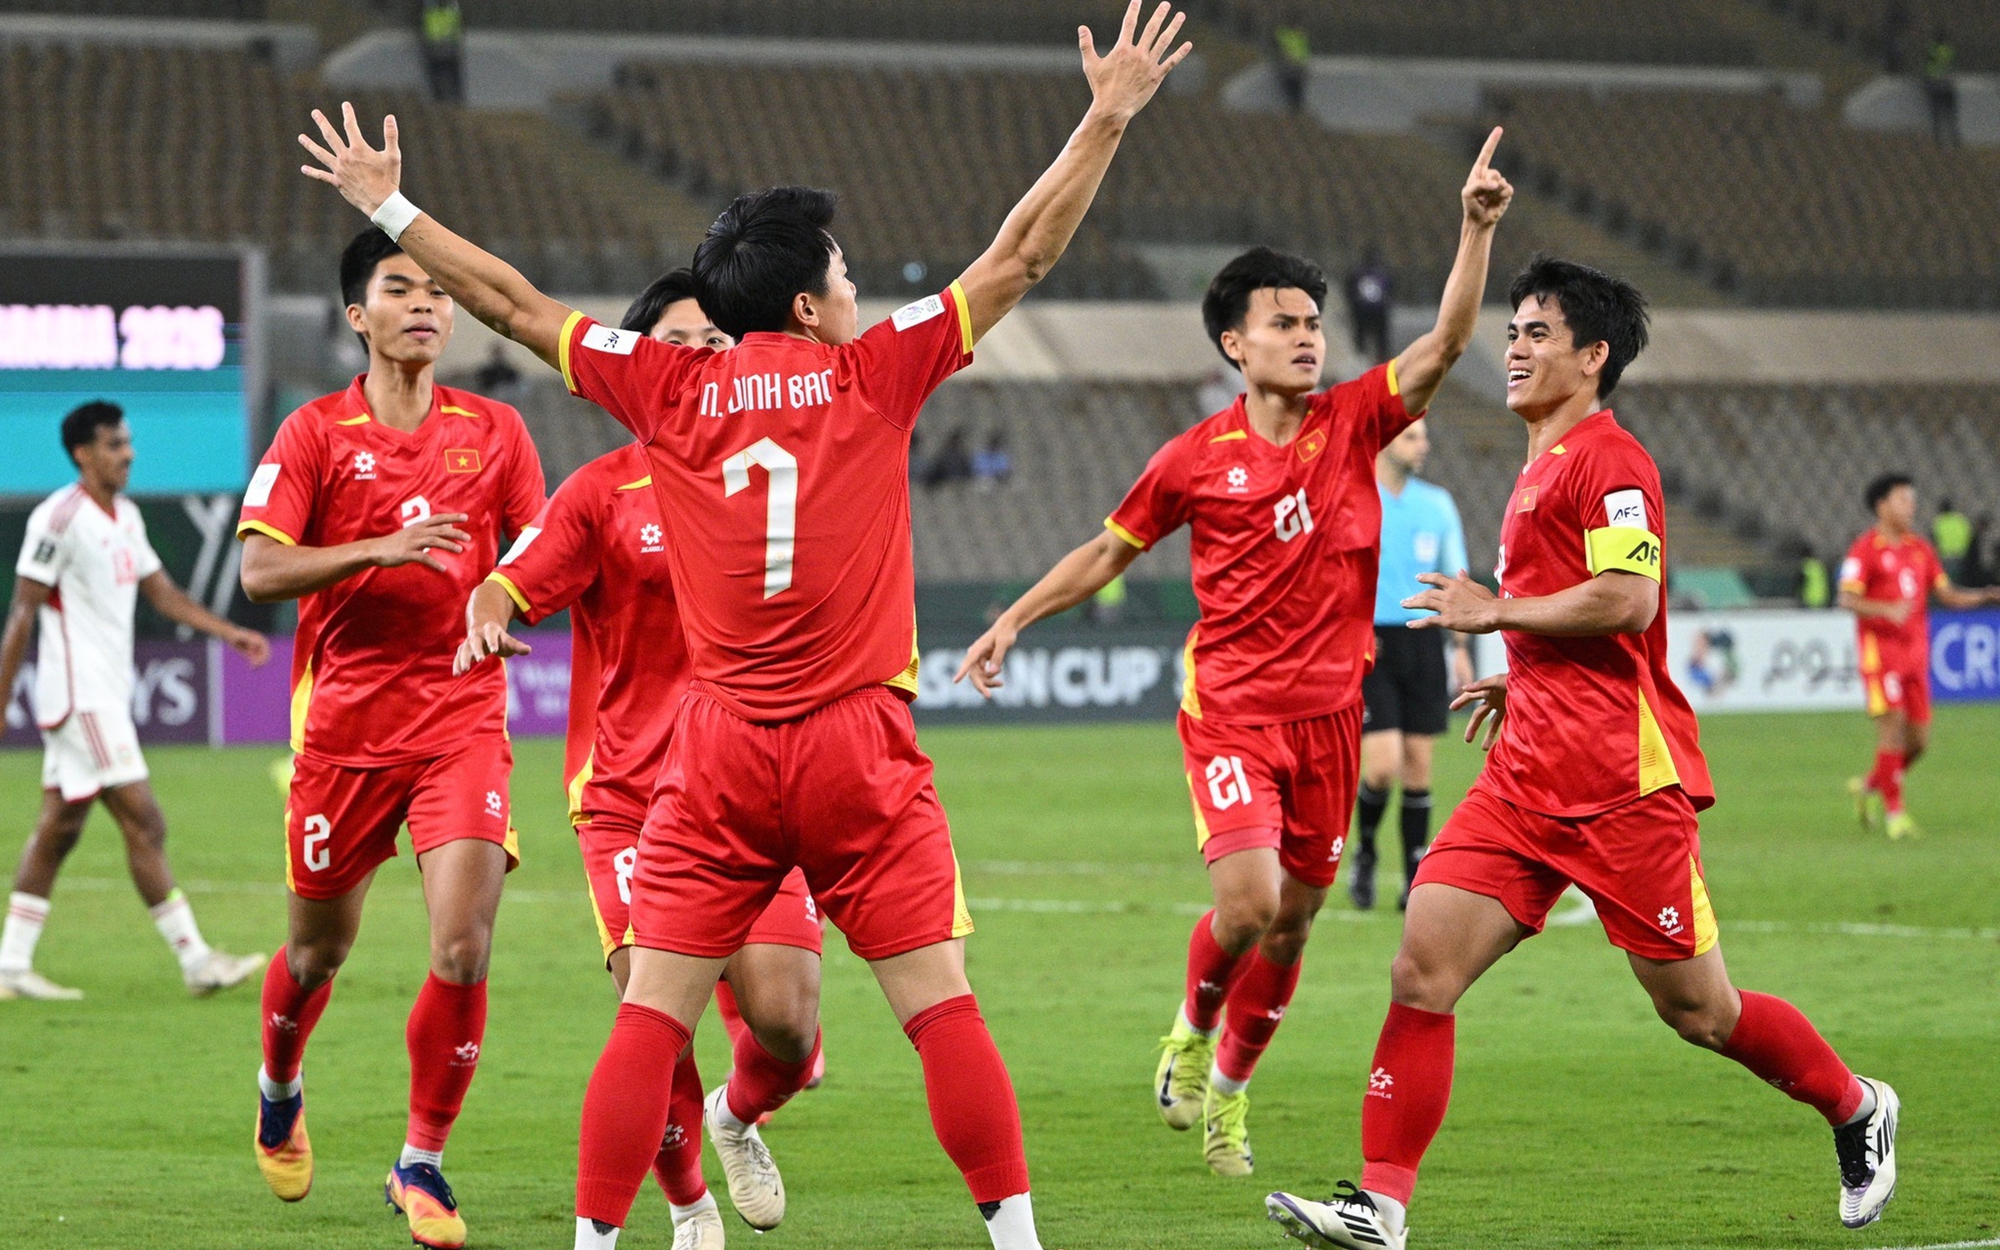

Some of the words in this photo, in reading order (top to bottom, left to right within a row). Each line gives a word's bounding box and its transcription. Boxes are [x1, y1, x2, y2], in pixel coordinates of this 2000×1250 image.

[721, 435, 799, 601] 7
[1273, 487, 1314, 543] 21
[1613, 505, 1640, 521] AFC
[1625, 540, 1660, 567] AF
[1051, 646, 1161, 706] CUP
[1932, 622, 2000, 691] CR
[1205, 755, 1253, 811] 21
[304, 814, 331, 873] 2
